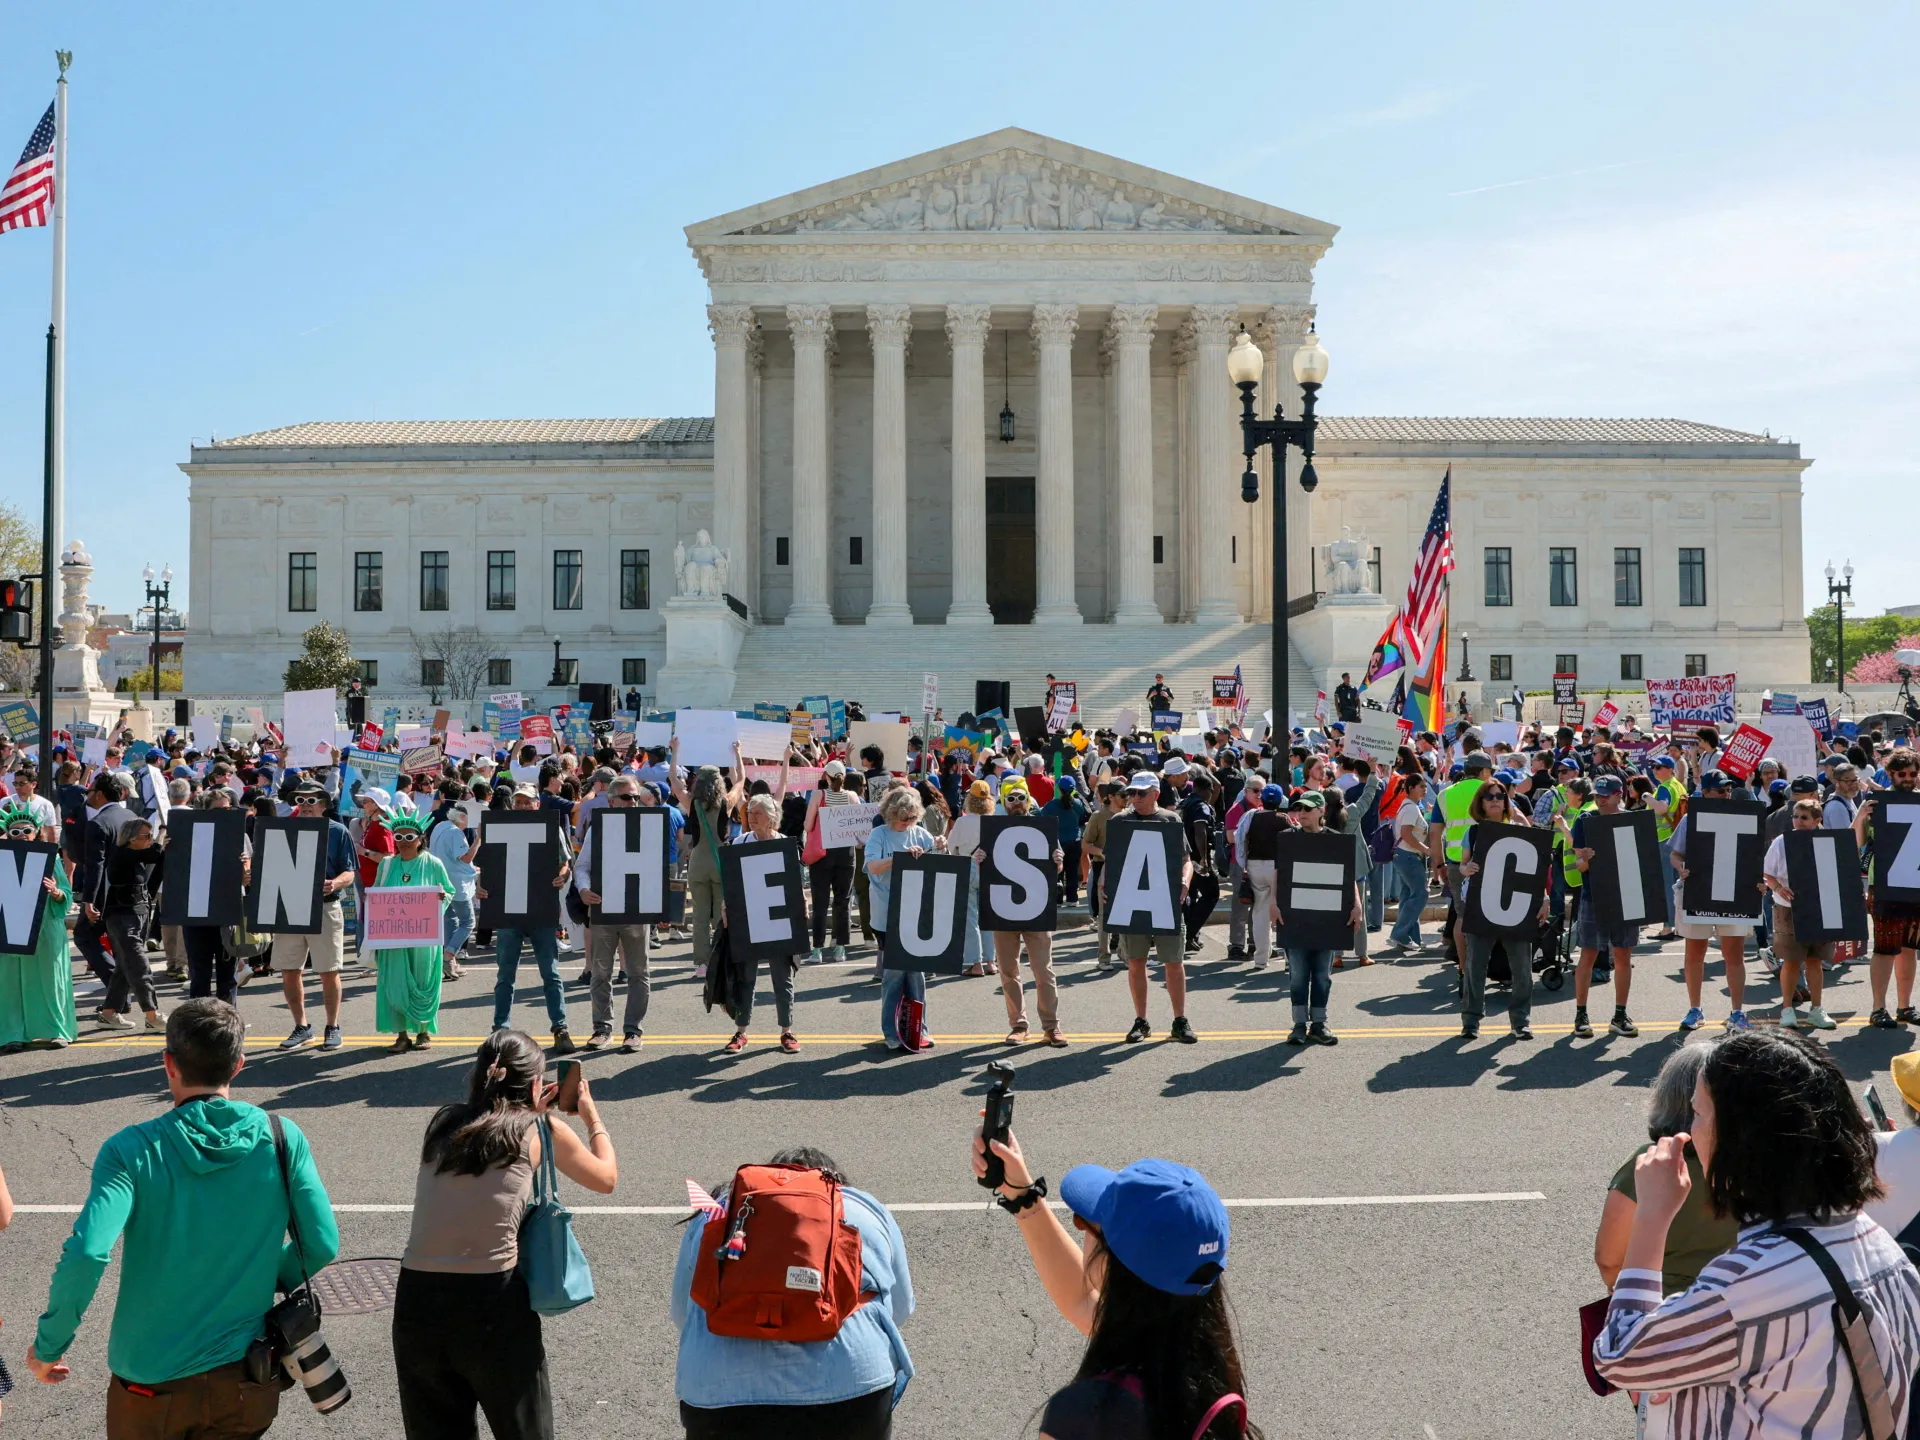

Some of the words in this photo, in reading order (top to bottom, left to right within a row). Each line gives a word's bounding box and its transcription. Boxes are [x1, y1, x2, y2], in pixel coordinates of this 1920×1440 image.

[1048, 718, 1063, 729] ALL
[1365, 737, 1386, 746] literally
[1734, 733, 1765, 755] BIRTH
[1728, 744, 1760, 765] RIGHT
[827, 807, 861, 819] NACIDO
[863, 806, 880, 816] AQU
[602, 813, 664, 914] H
[1697, 812, 1758, 902] T
[257, 828, 319, 926] N
[486, 823, 547, 914] T
[990, 825, 1049, 920] S
[1109, 830, 1175, 930] A
[1480, 836, 1538, 927] C
[371, 892, 427, 905] CITIZENSHIP
[740, 851, 793, 944] E
[388, 907, 395, 916] IS
[400, 907, 406, 916] A
[899, 869, 958, 957] U
[368, 917, 431, 935] BIRTHRIGHT
[1198, 1240, 1219, 1256] ACLU
[790, 1272, 812, 1280] NORTH
